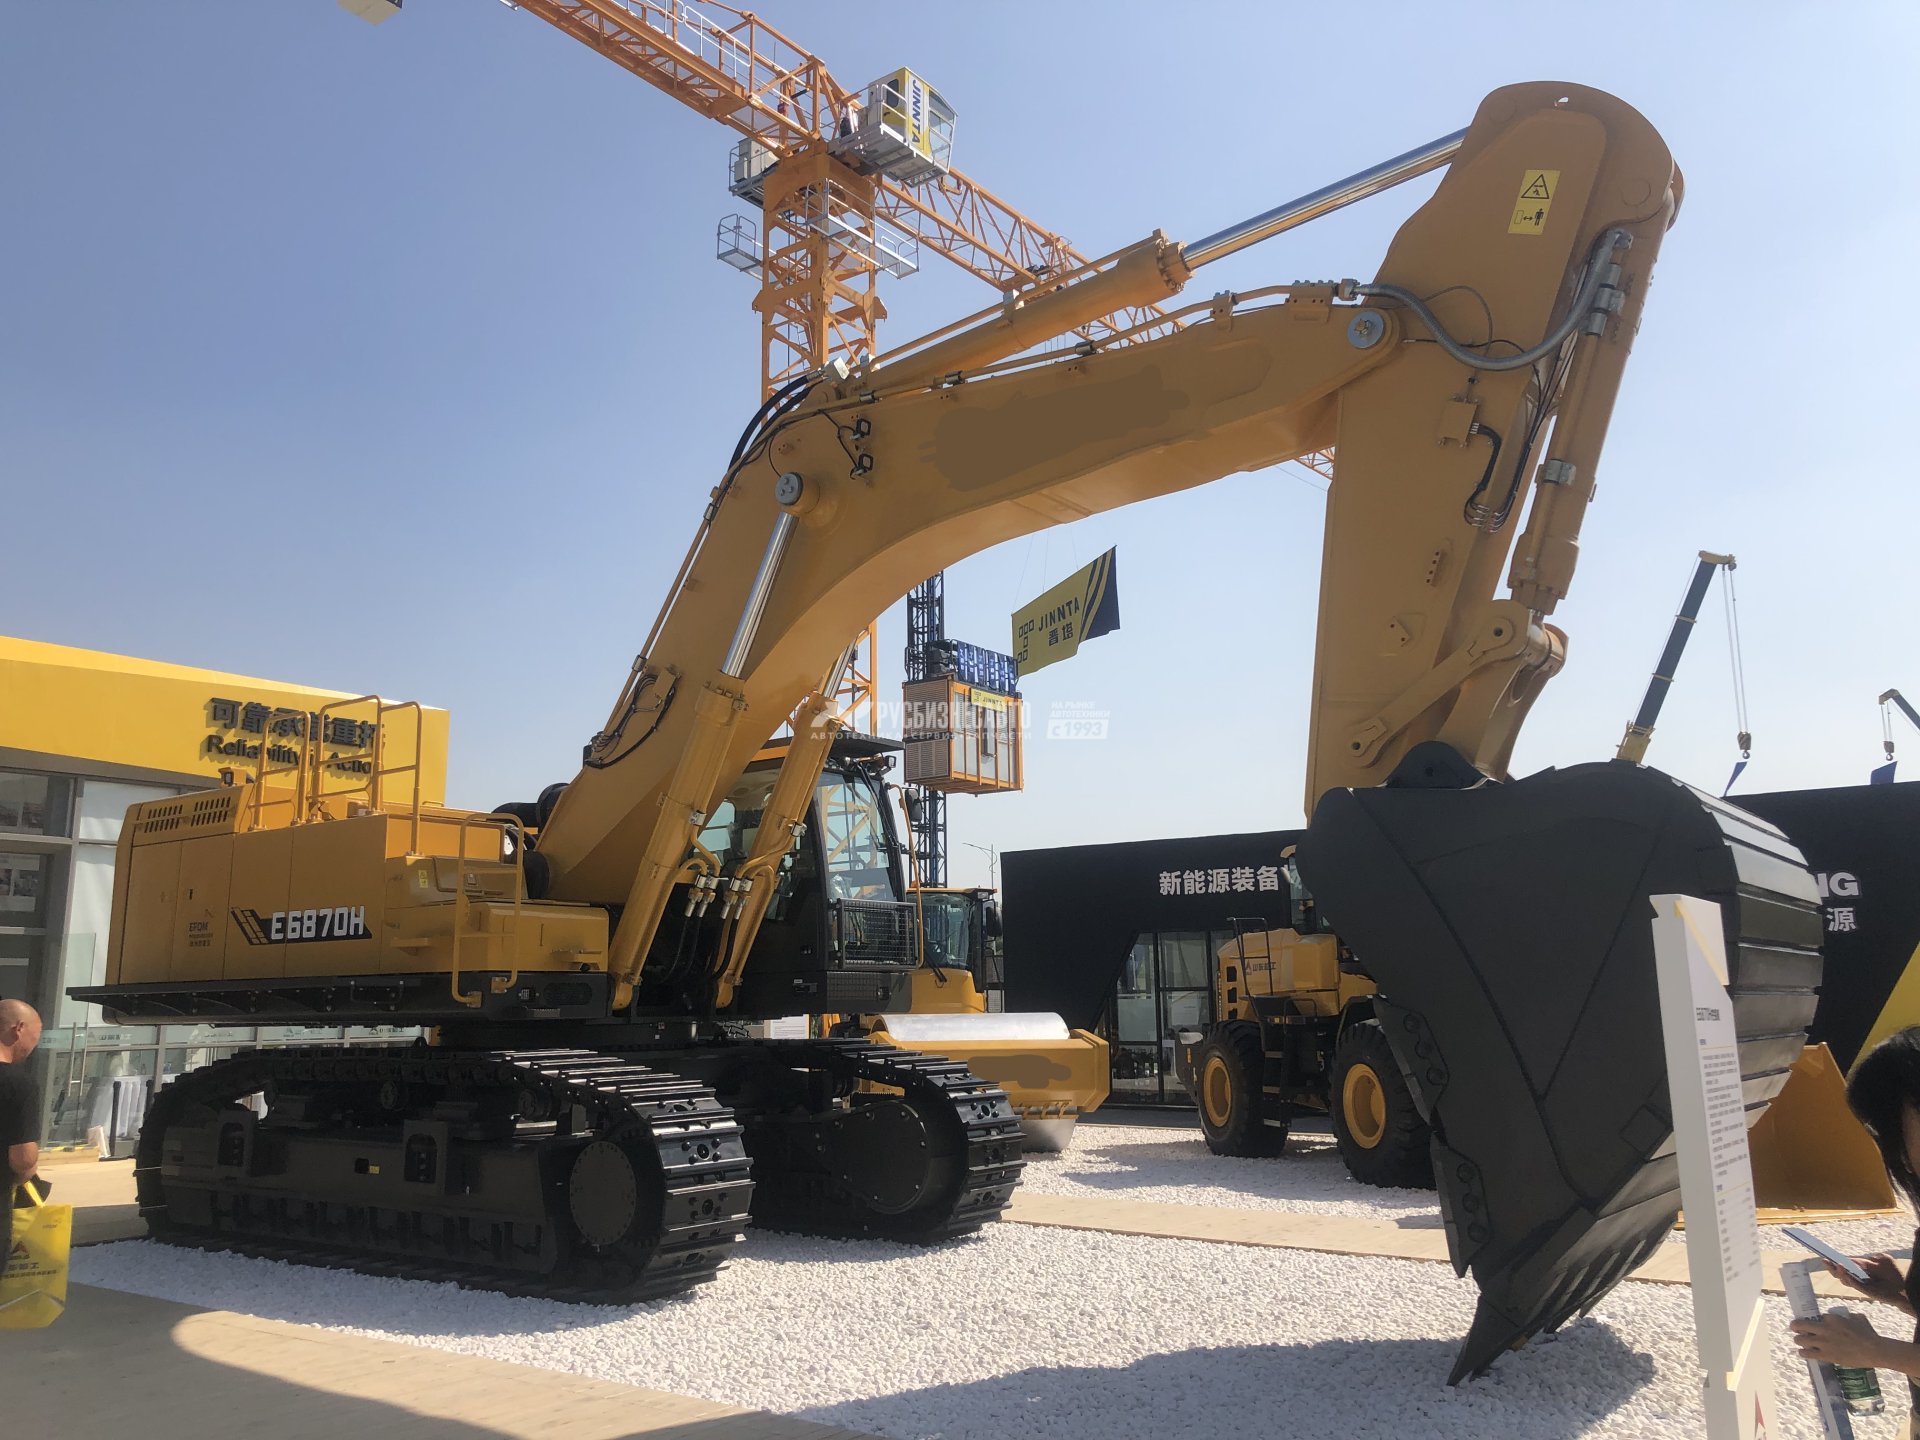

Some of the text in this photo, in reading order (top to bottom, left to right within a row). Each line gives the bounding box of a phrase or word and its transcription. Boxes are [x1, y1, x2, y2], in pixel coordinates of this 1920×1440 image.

[912, 80, 922, 142] JINNTA
[1039, 597, 1079, 631] JINNTA
[1048, 622, 1073, 646] 晋塔
[1159, 865, 1289, 896] 新能源装备
[271, 906, 365, 940] E6870H
[1826, 907, 1857, 932] 源
